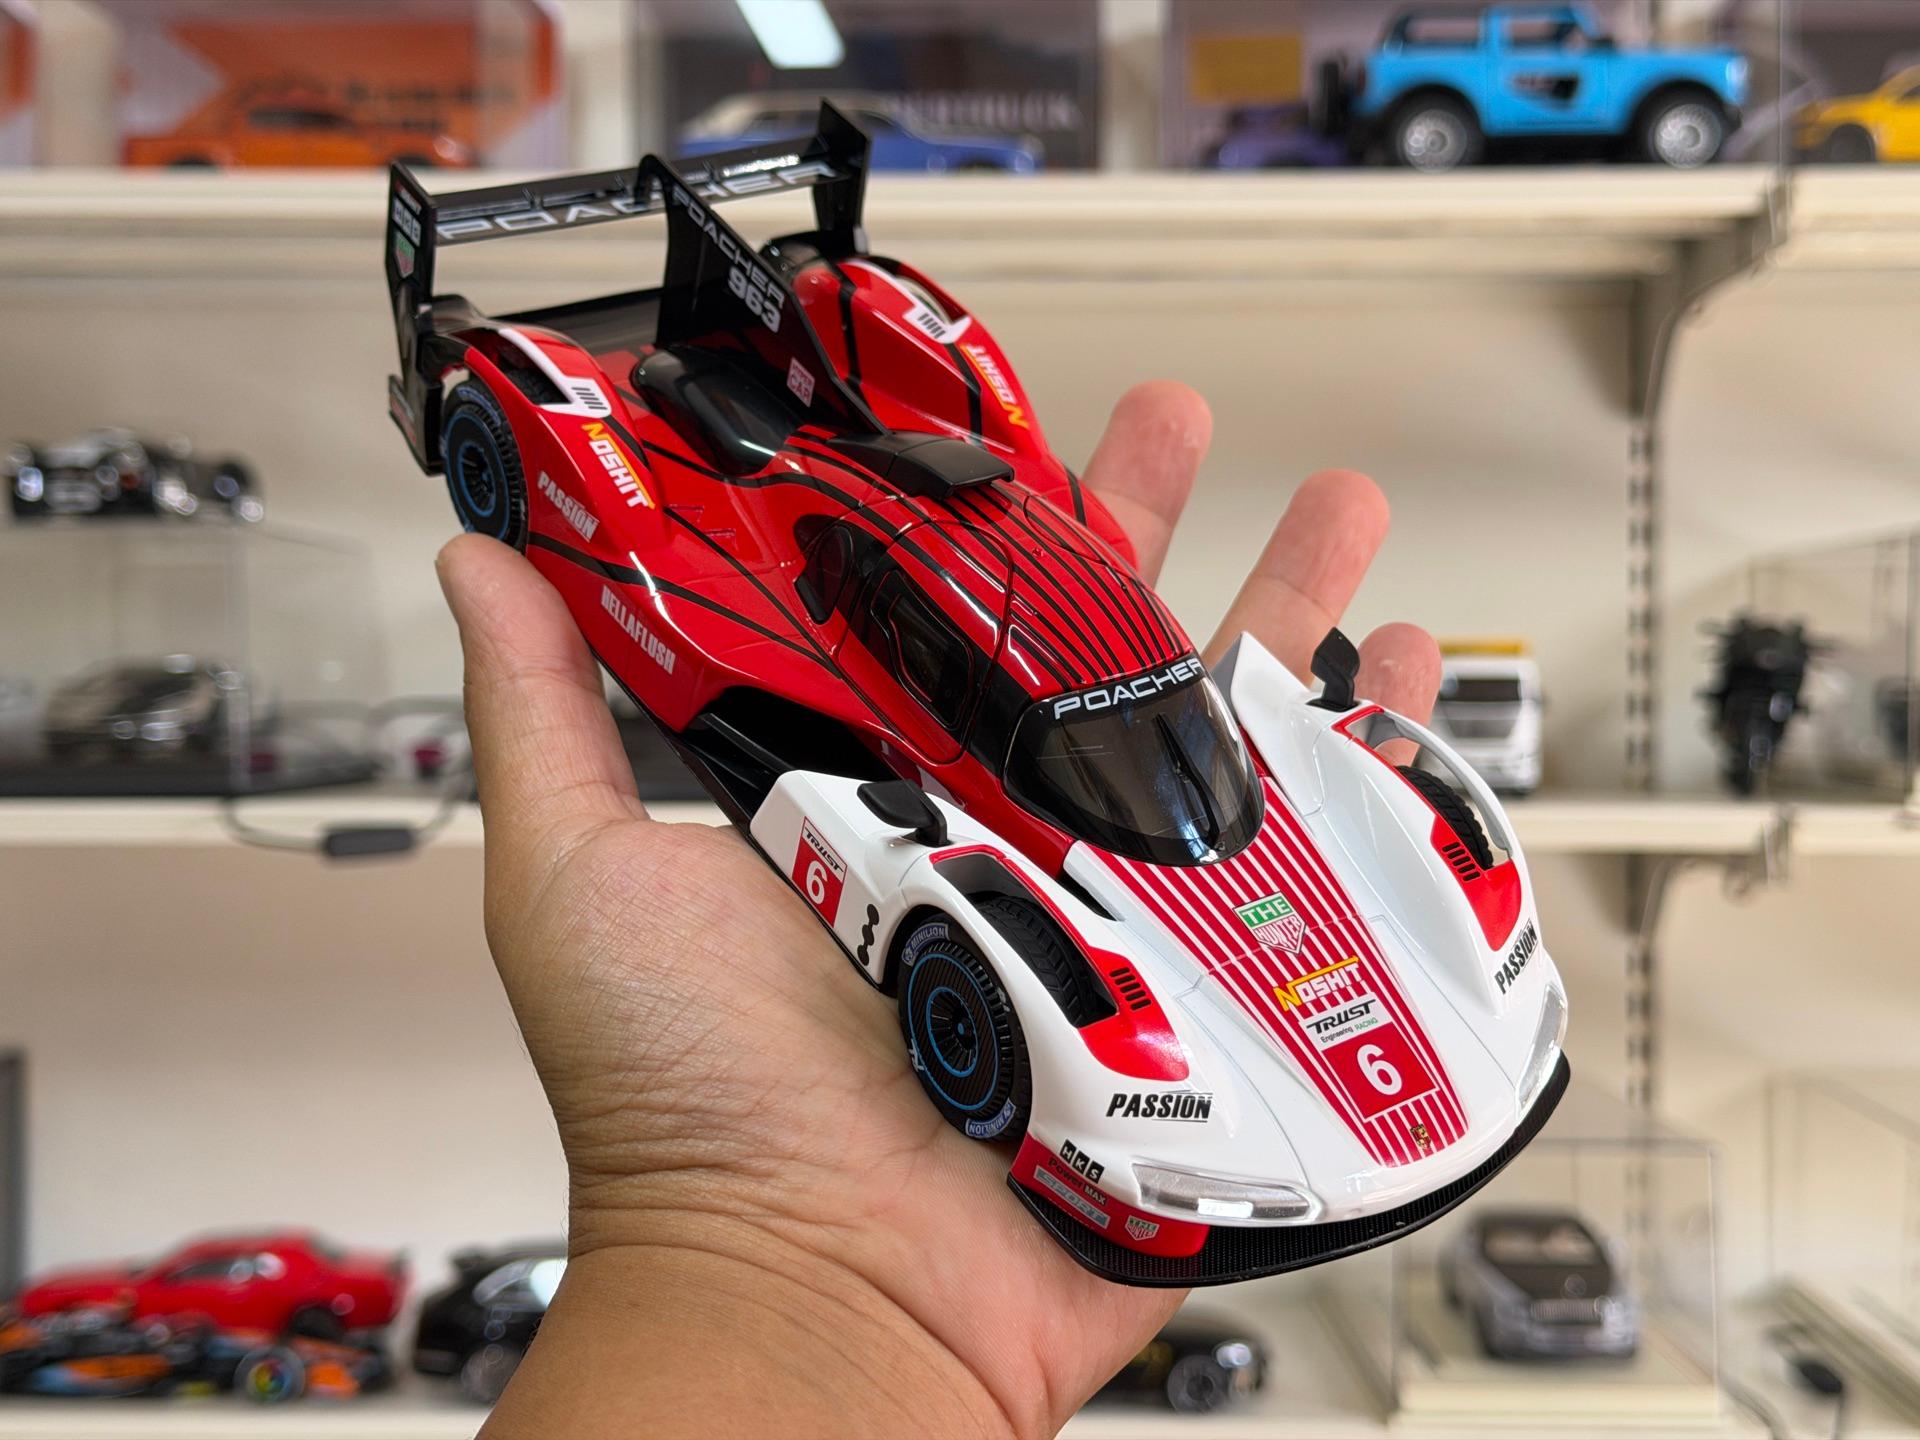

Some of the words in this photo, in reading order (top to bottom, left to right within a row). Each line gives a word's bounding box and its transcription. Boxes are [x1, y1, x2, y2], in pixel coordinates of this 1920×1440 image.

[672, 184, 786, 310] POACHER
[727, 265, 782, 334] 963
[960, 343, 1030, 430] NOSHIT
[582, 421, 656, 510] NOSHIT
[537, 471, 600, 543] PASSION
[1053, 656, 1206, 720] POACHER
[804, 826, 844, 873] TRUST
[806, 860, 828, 905] 6
[1242, 896, 1292, 927] THE
[1255, 915, 1303, 949] HUNTER
[1494, 918, 1539, 995] PASSION
[1272, 955, 1364, 1012] NOSHIT
[1306, 999, 1376, 1034] TRUST
[1319, 1026, 1354, 1044] Engineering
[1354, 1016, 1378, 1033] RACING
[1357, 1043, 1403, 1096] 6
[1105, 1092, 1214, 1120] PASSION
[1060, 1141, 1103, 1183] HKS
[1084, 1184, 1107, 1206] MAX
